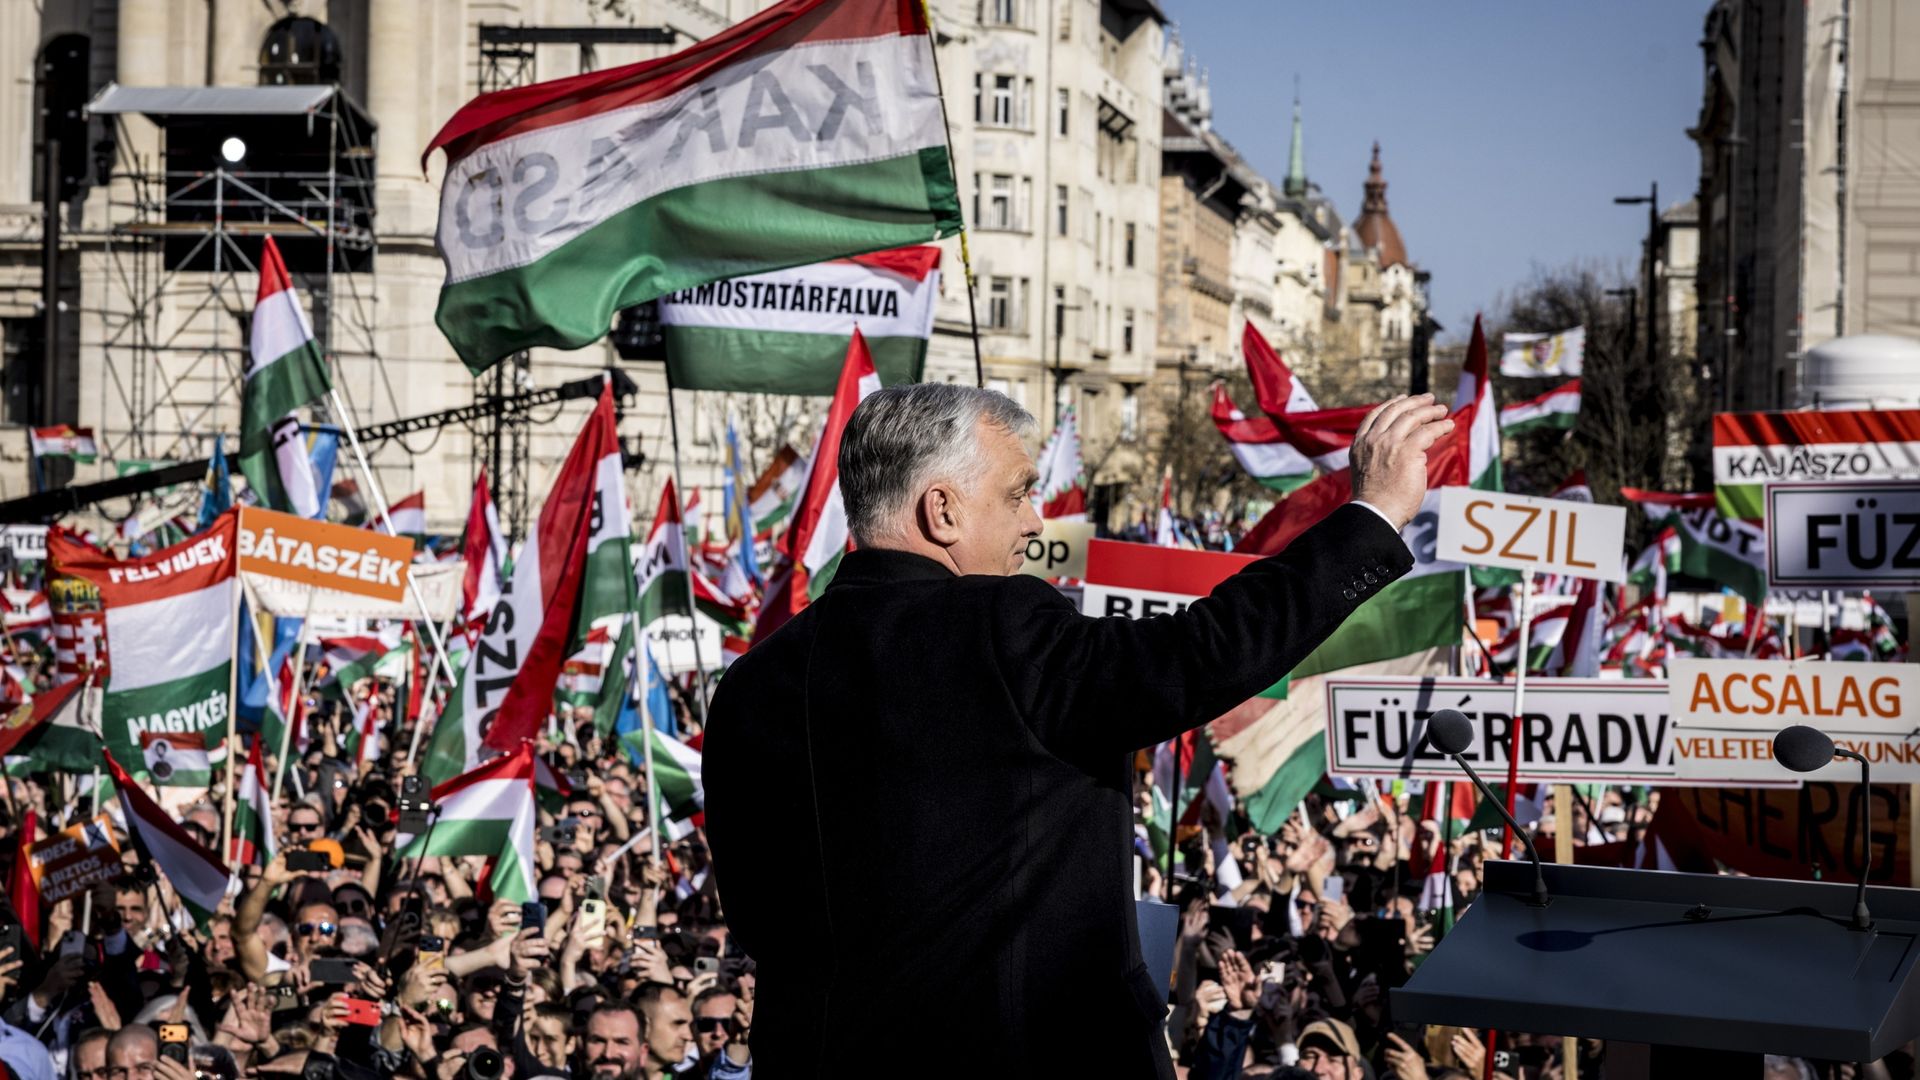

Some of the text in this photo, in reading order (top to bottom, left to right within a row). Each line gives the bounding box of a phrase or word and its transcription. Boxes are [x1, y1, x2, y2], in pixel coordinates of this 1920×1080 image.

[239, 528, 404, 587] BÁTASZÉK
[1462, 500, 1596, 569] SZIL
[1807, 498, 1920, 570] FÜZ
[1105, 594, 1187, 620] BE
[1690, 673, 1901, 718] ACSALAG
[1344, 694, 1674, 766] FÜZRRADV
